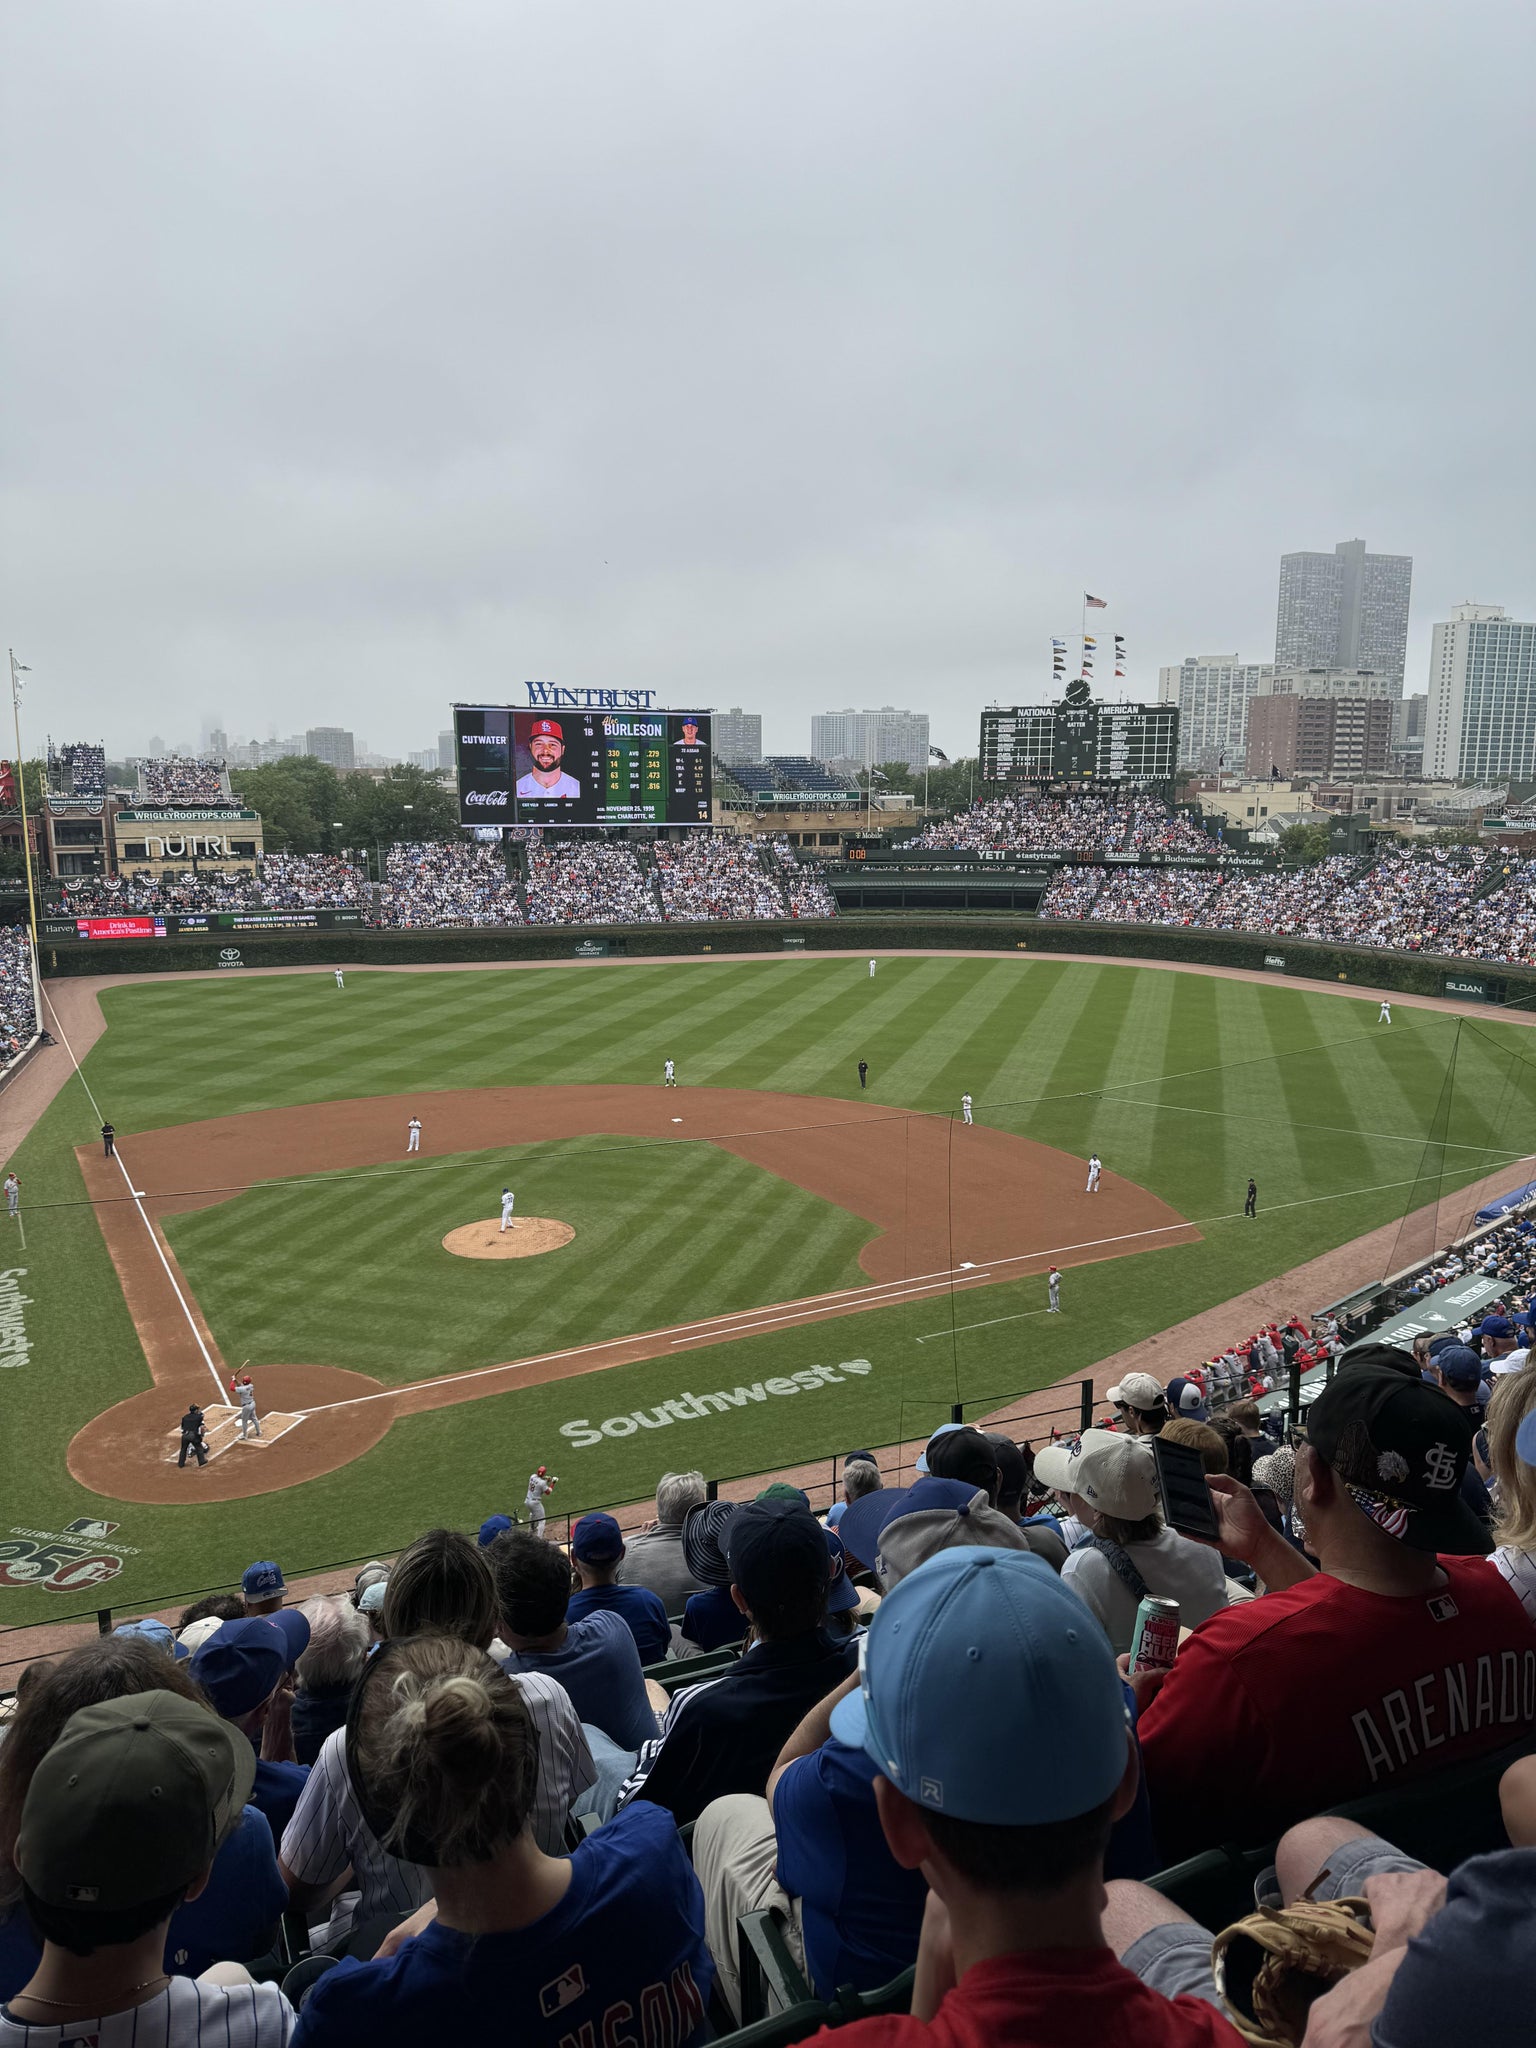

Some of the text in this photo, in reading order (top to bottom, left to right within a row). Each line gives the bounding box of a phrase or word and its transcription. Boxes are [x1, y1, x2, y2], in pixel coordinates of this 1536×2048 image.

[524, 681, 656, 708] WINTRUST
[1017, 705, 1139, 717] NATIONAL AMERICAN
[584, 727, 594, 736] 1B
[604, 723, 662, 737] BURLESON
[1070, 728, 1081, 737] 41
[462, 735, 507, 744] CUTWATER
[607, 749, 620, 757] 330
[646, 750, 660, 758] .279
[610, 760, 618, 768] 14
[646, 760, 660, 768] .343
[610, 771, 619, 779] 63
[646, 771, 660, 779] .473
[610, 782, 619, 790] 45
[647, 782, 660, 790] .816
[772, 792, 847, 800] WRIGLEYROOFTOPS.COM
[134, 811, 241, 820] WRIGLEYROOFTOPS.COM
[698, 811, 708, 820] 14
[862, 831, 882, 839] Mobile
[977, 850, 1061, 861] YETI tastytrade
[1227, 856, 1264, 866] Advocate
[46, 924, 75, 934] Harvey
[92, 926, 152, 936] America's Pastime
[1265, 956, 1285, 966] Hefty
[1445, 982, 1483, 994] SLOAN
[1444, 1279, 1497, 1307] WINTRUST
[559, 1364, 846, 1448] Southwest
[10, 1526, 142, 1555] CELEBRATING AMERICA'S
[1140, 1640, 1177, 1660] HUG
[1351, 1650, 1536, 1783] ARENADO
